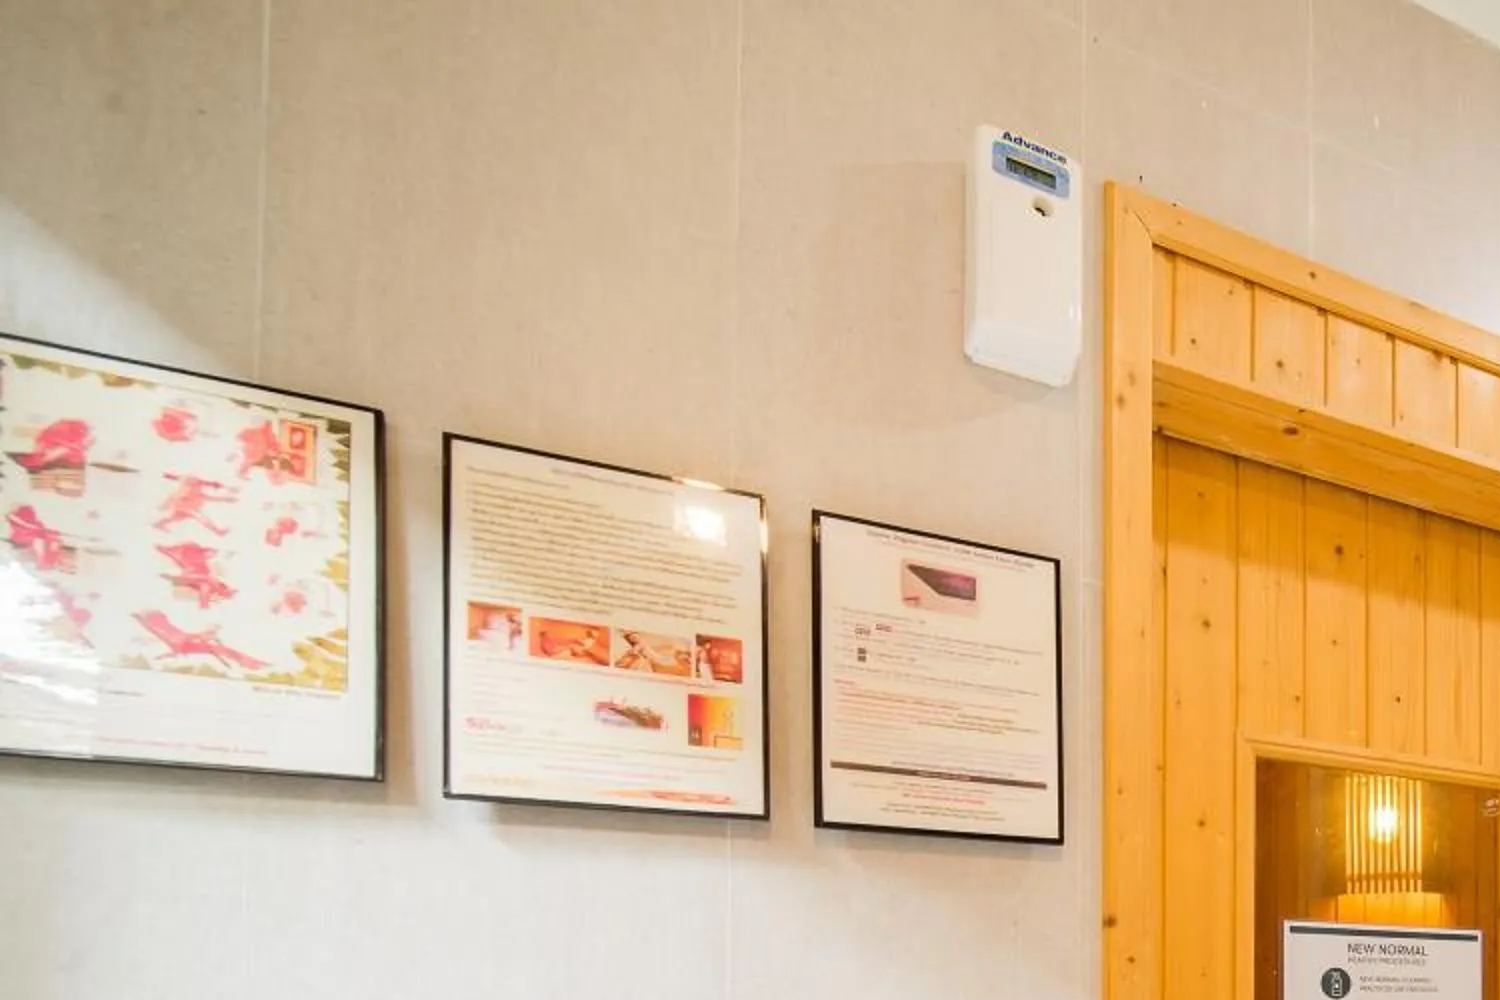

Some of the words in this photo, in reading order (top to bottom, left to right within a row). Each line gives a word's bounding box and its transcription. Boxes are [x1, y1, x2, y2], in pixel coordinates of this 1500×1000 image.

[1002, 131, 1067, 165] Advance
[1347, 943, 1376, 955] NEW
[1379, 943, 1429, 957] NORMAL
